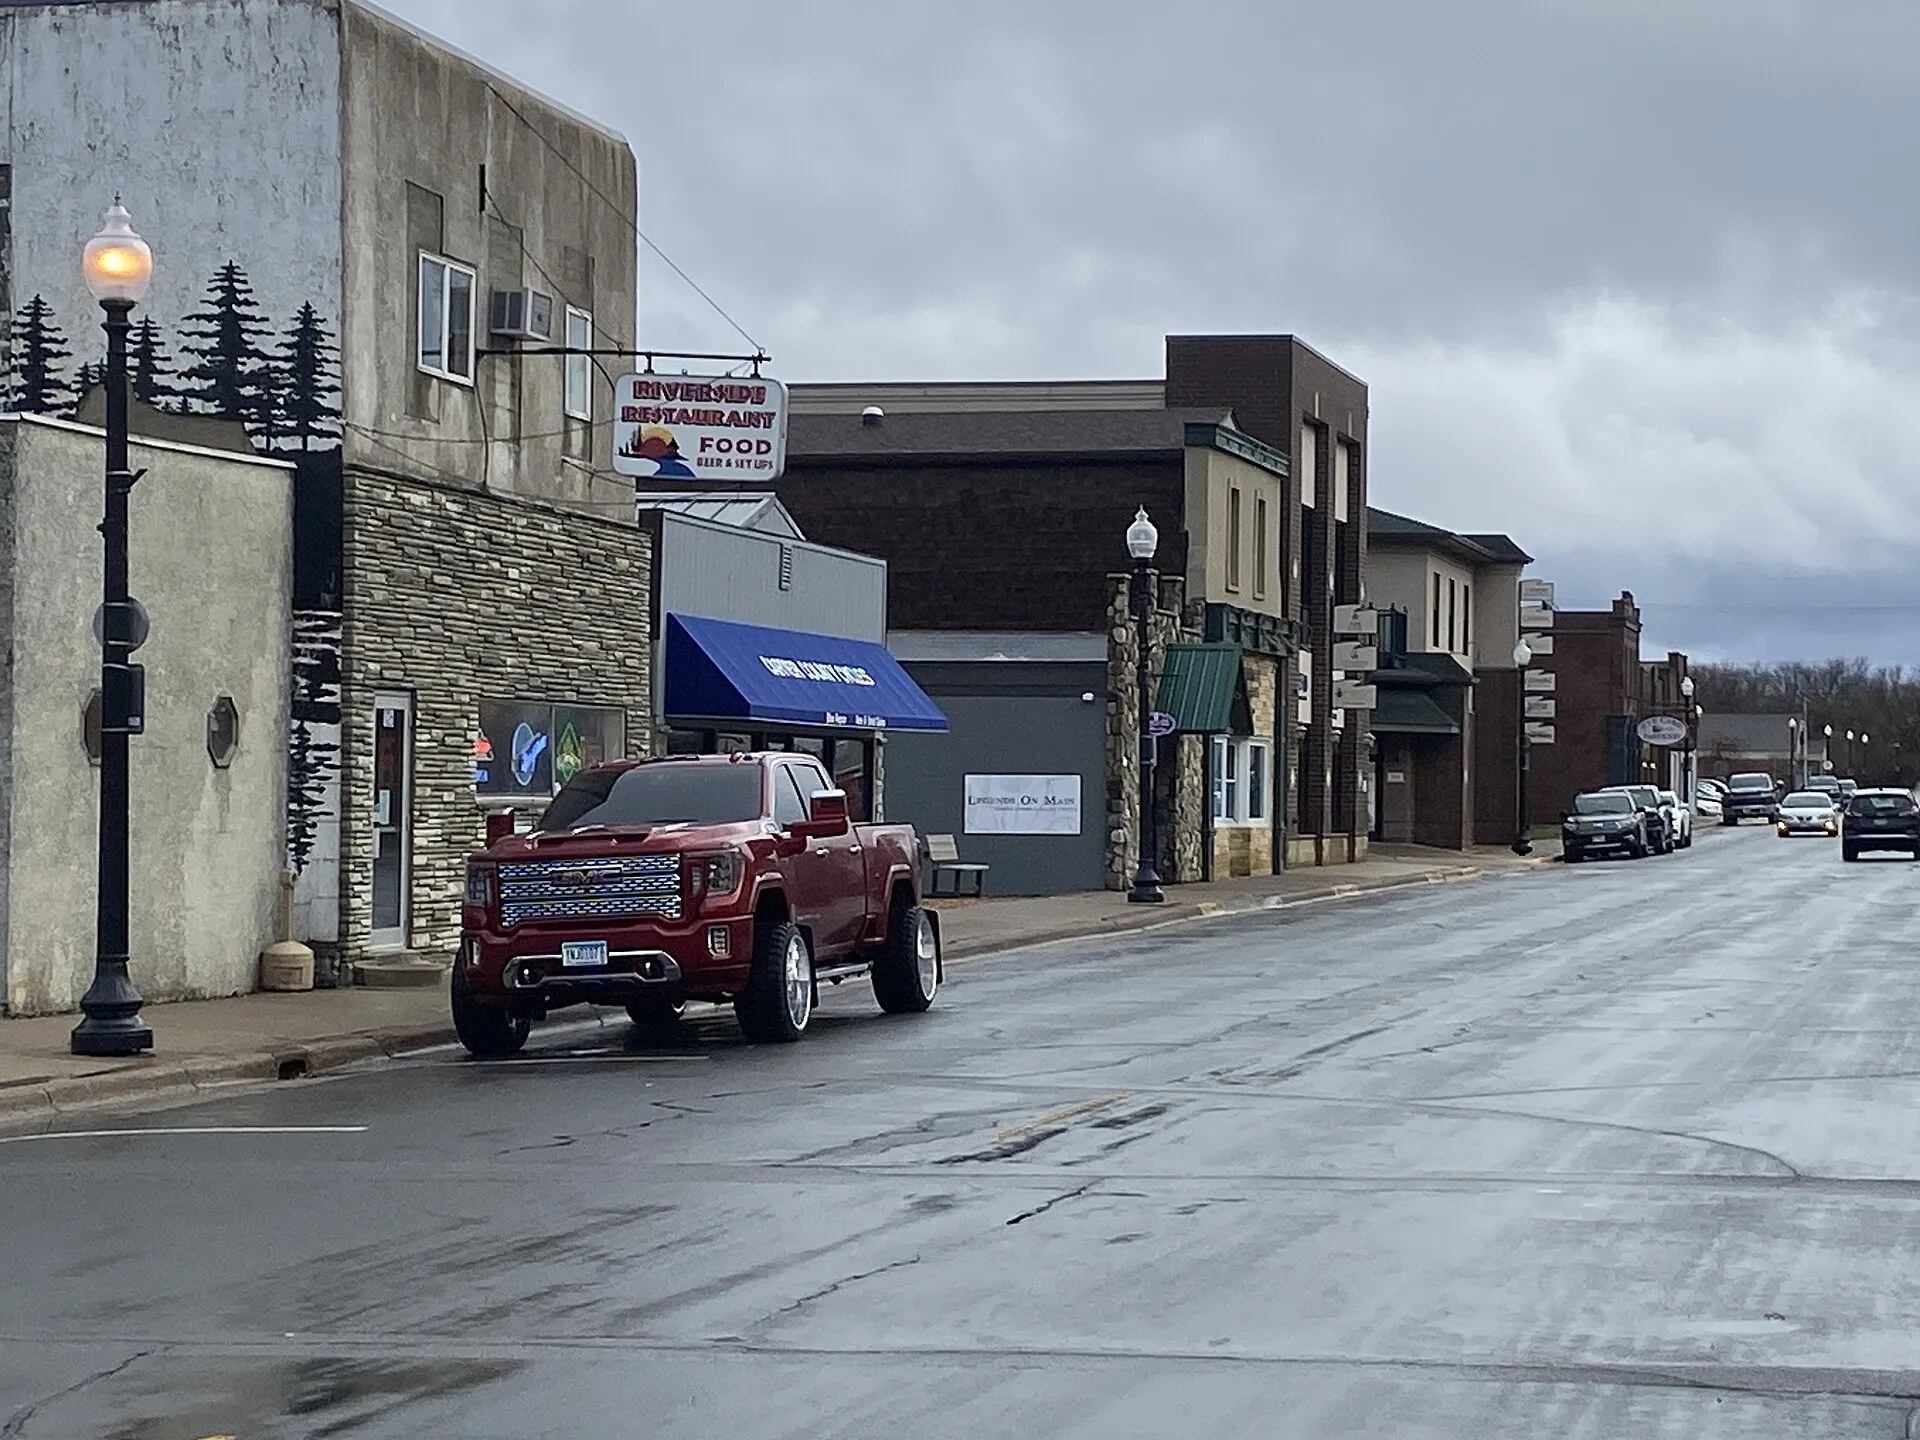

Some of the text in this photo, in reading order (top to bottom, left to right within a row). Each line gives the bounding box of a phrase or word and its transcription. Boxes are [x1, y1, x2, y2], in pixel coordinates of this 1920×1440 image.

[633, 380, 767, 405] RIVERSIDE
[621, 406, 777, 429] RESTAURANT
[699, 436, 772, 455] FOOD
[696, 457, 723, 468] BEER
[725, 458, 733, 468] &
[1020, 795, 1039, 806] ON
